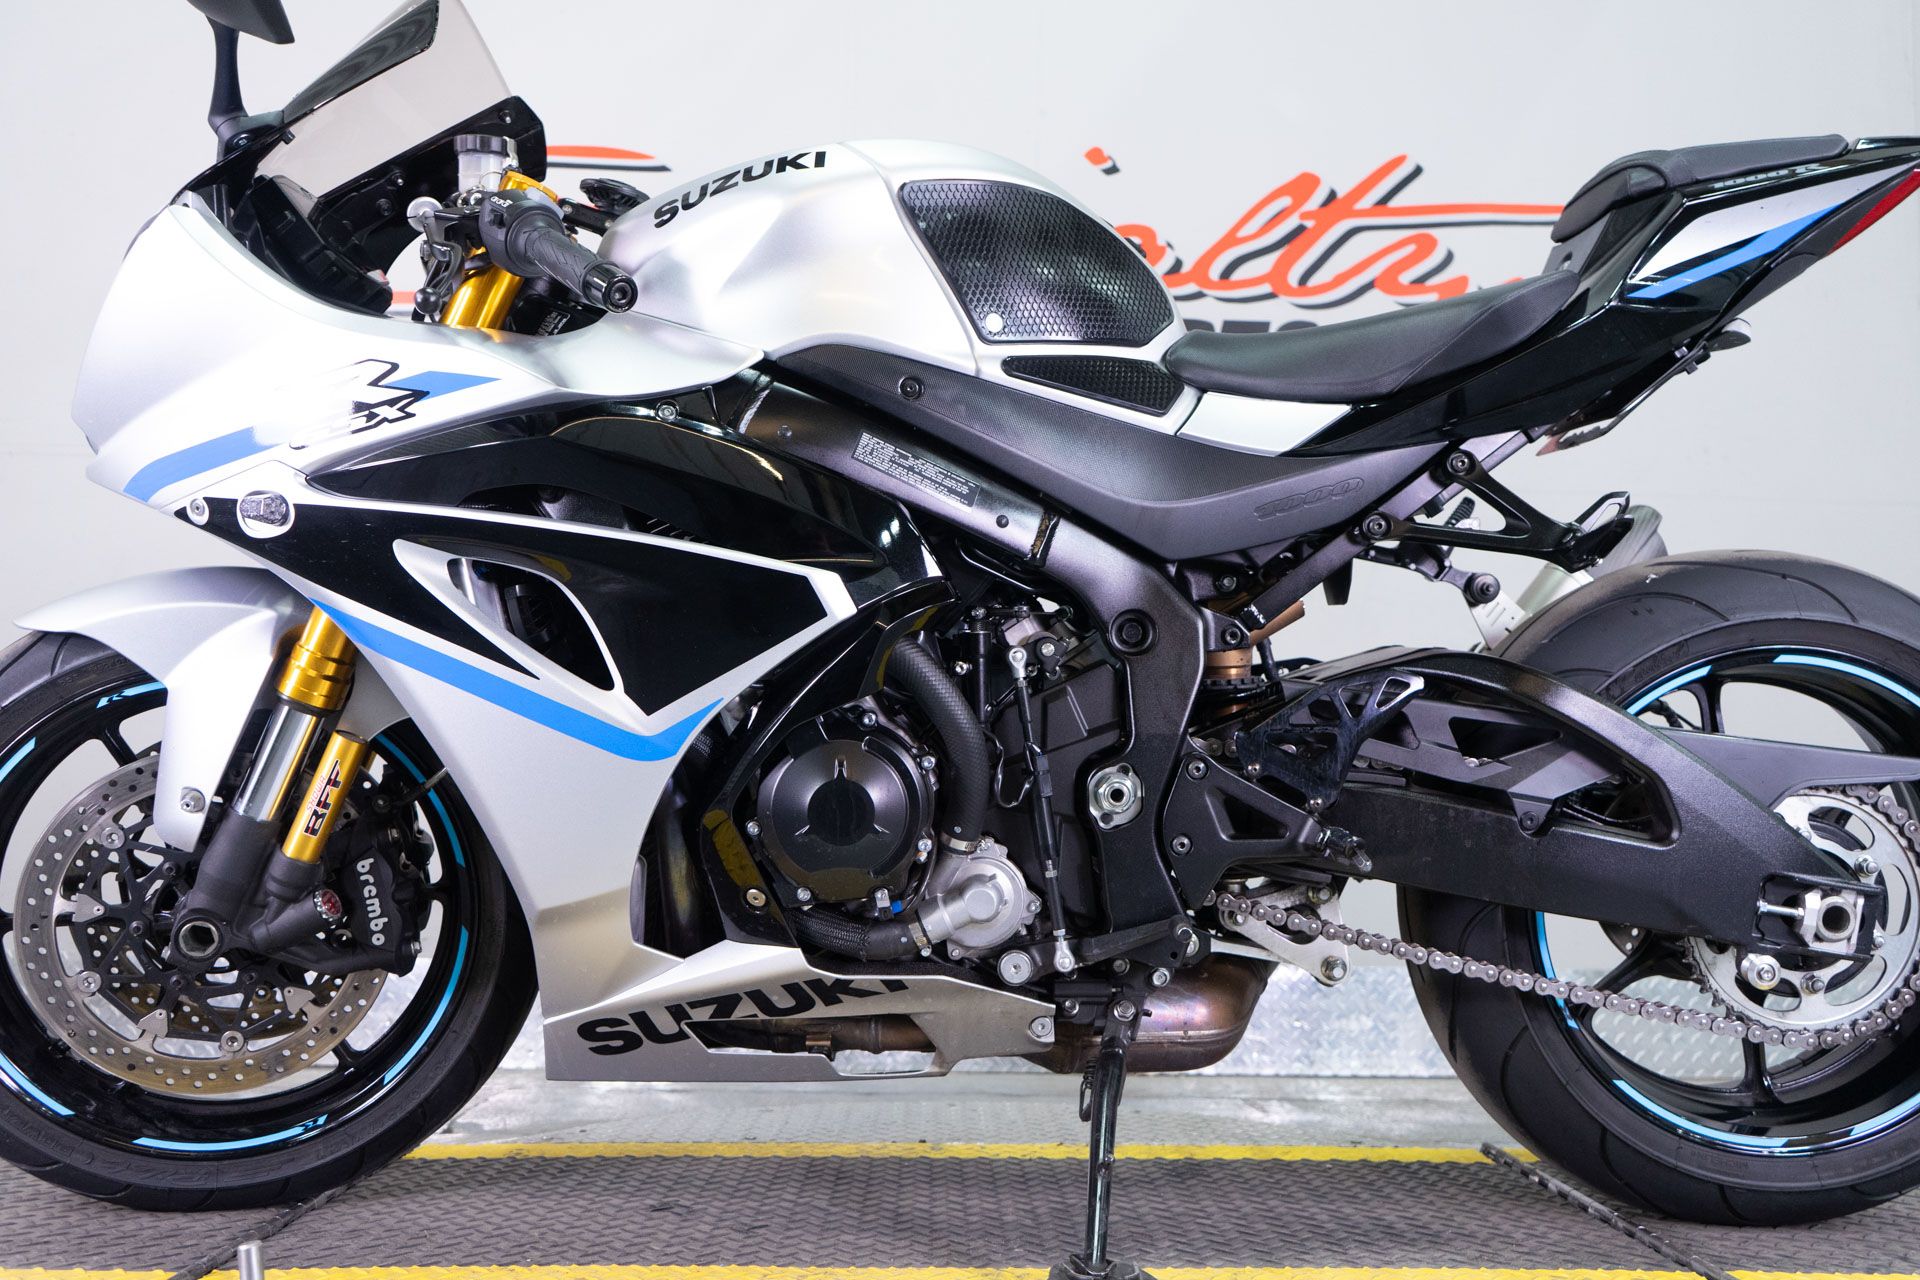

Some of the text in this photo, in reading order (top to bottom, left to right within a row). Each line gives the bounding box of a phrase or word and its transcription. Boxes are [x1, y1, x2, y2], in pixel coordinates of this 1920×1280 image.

[653, 150, 826, 229] SUZUKI
[307, 775, 326, 811] SHOWA
[356, 857, 389, 946] brembo
